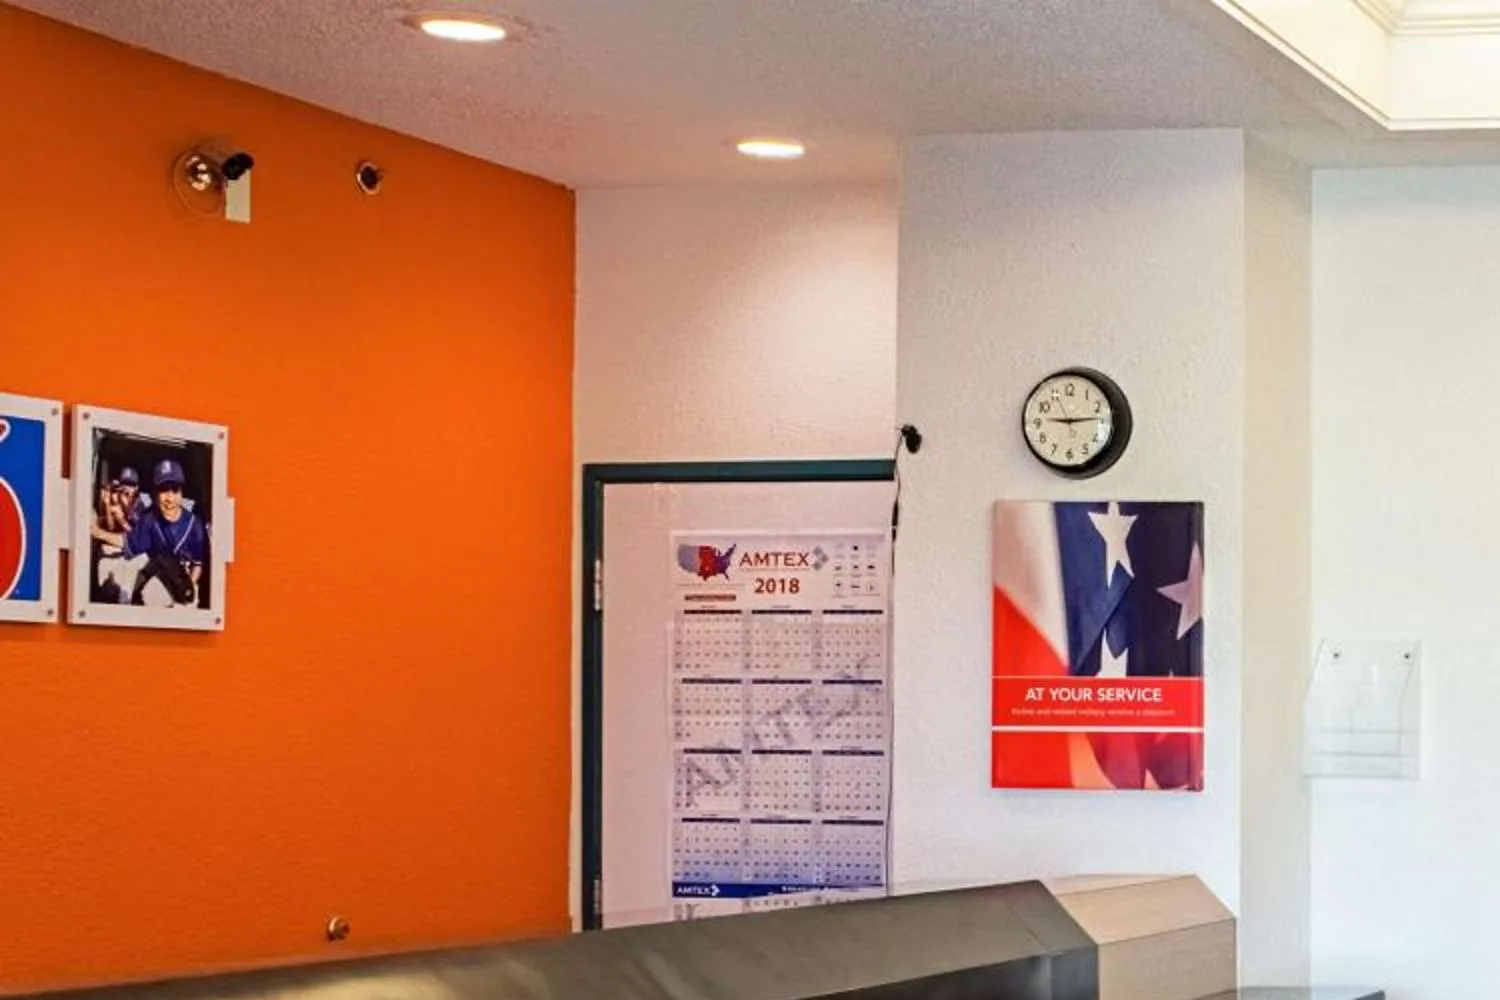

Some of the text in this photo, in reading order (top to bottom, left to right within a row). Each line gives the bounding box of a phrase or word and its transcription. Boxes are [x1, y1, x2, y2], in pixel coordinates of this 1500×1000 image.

[739, 552, 810, 567] AMTEX
[754, 577, 801, 594] 2018
[1025, 687, 1163, 702] AT YOUR SERVICE
